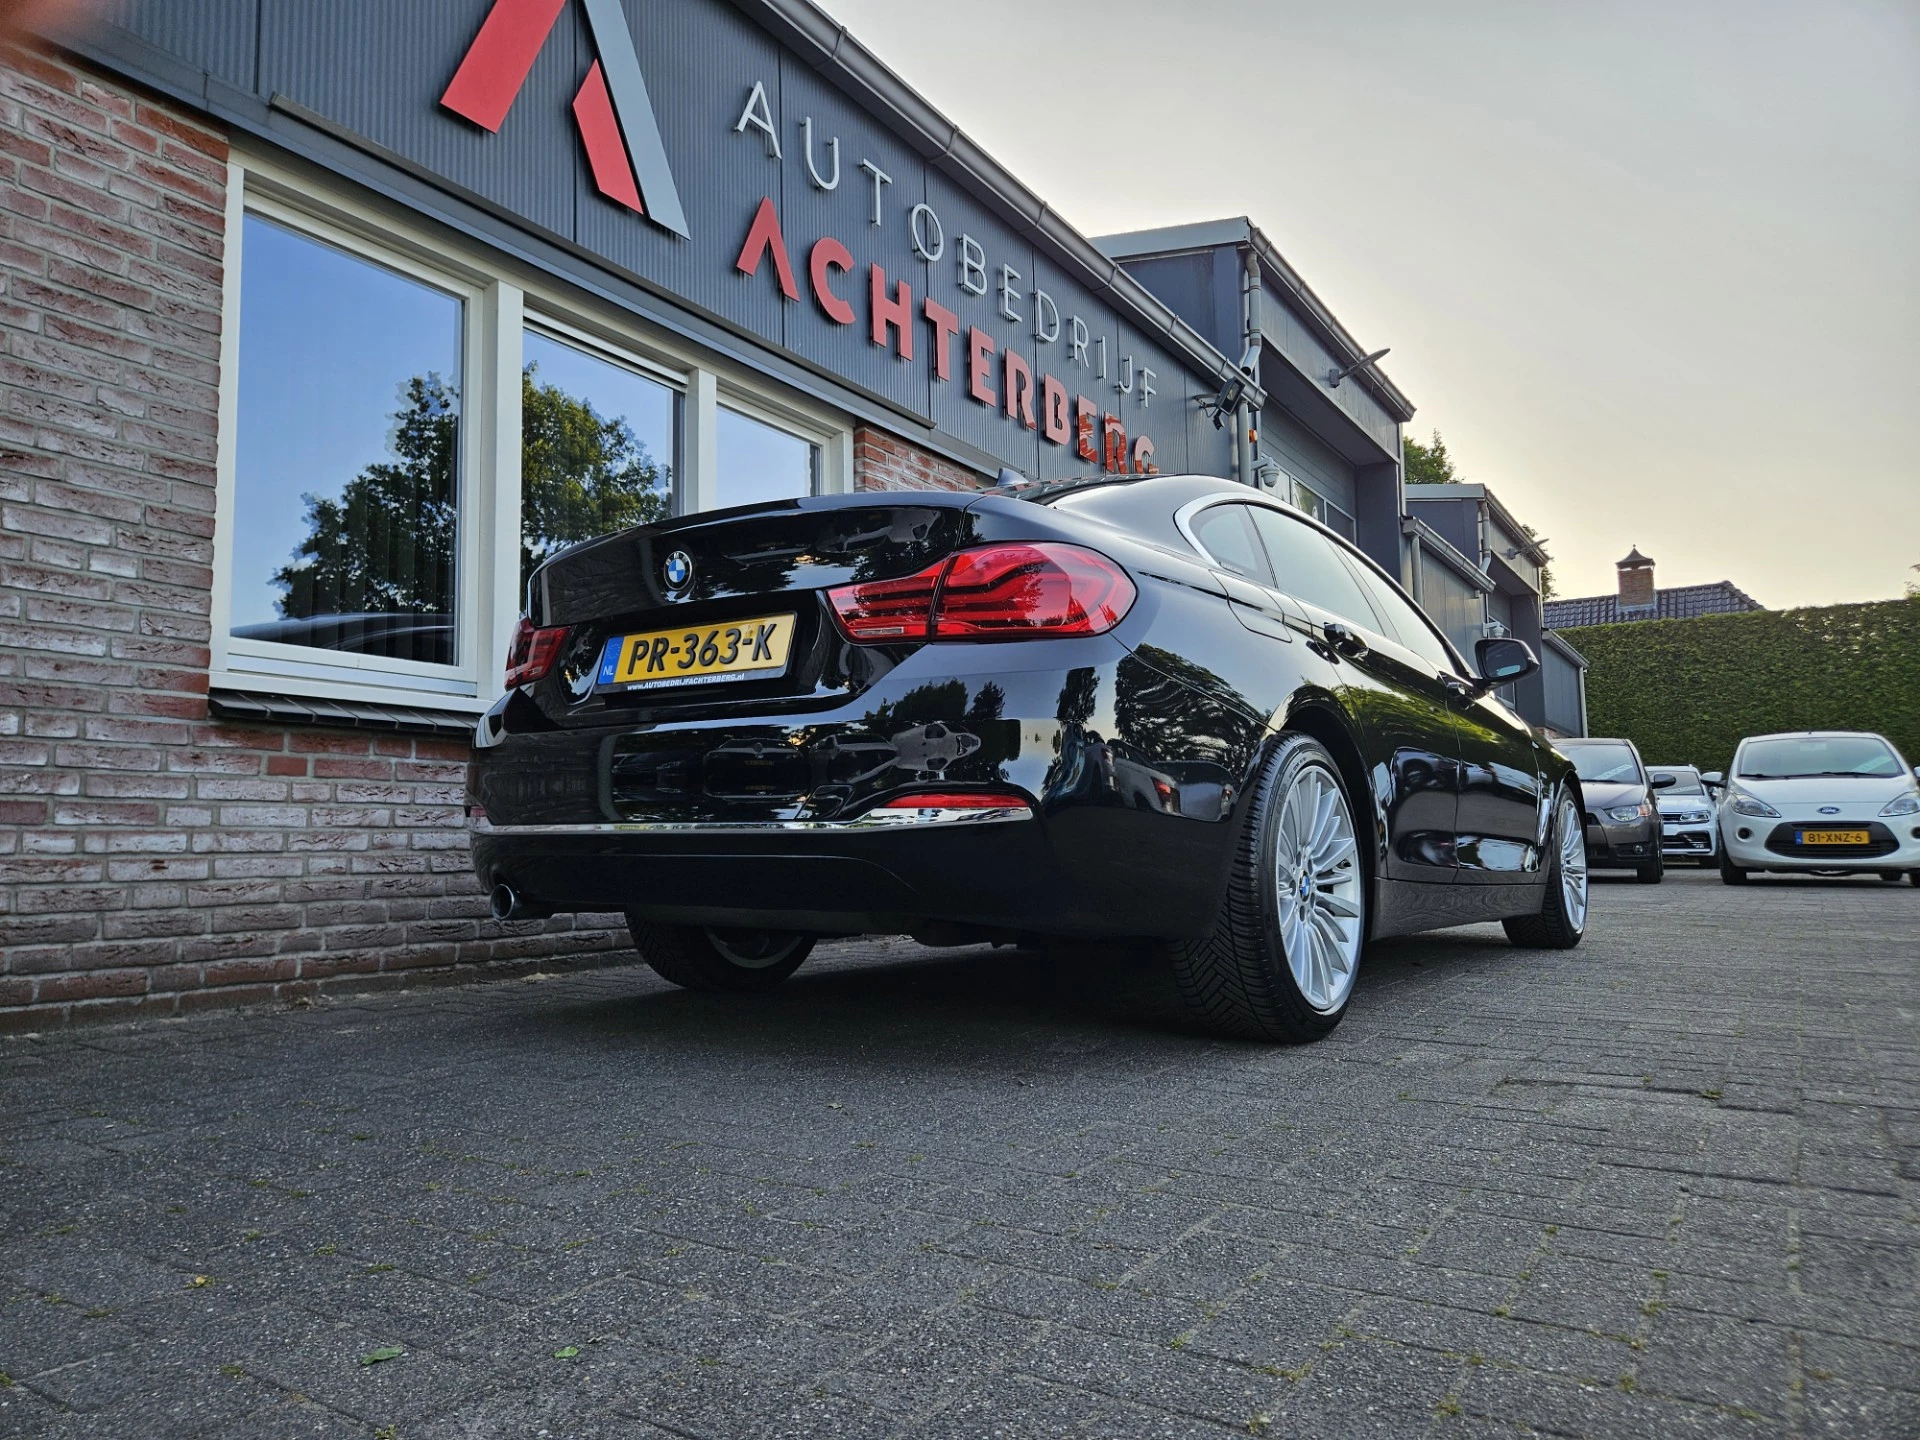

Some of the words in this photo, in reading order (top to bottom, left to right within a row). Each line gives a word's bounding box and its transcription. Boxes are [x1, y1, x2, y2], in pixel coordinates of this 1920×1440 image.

[737, 80, 1156, 408] AUTOBEDRIJF
[736, 195, 1160, 475] ACHTERBERG
[627, 624, 777, 675] PR-363-K
[602, 664, 614, 676] NL
[627, 672, 745, 691] www.AUTOBEDRIJFACHTERBERG.nl
[1808, 833, 1863, 843] 81-XNZ-6
